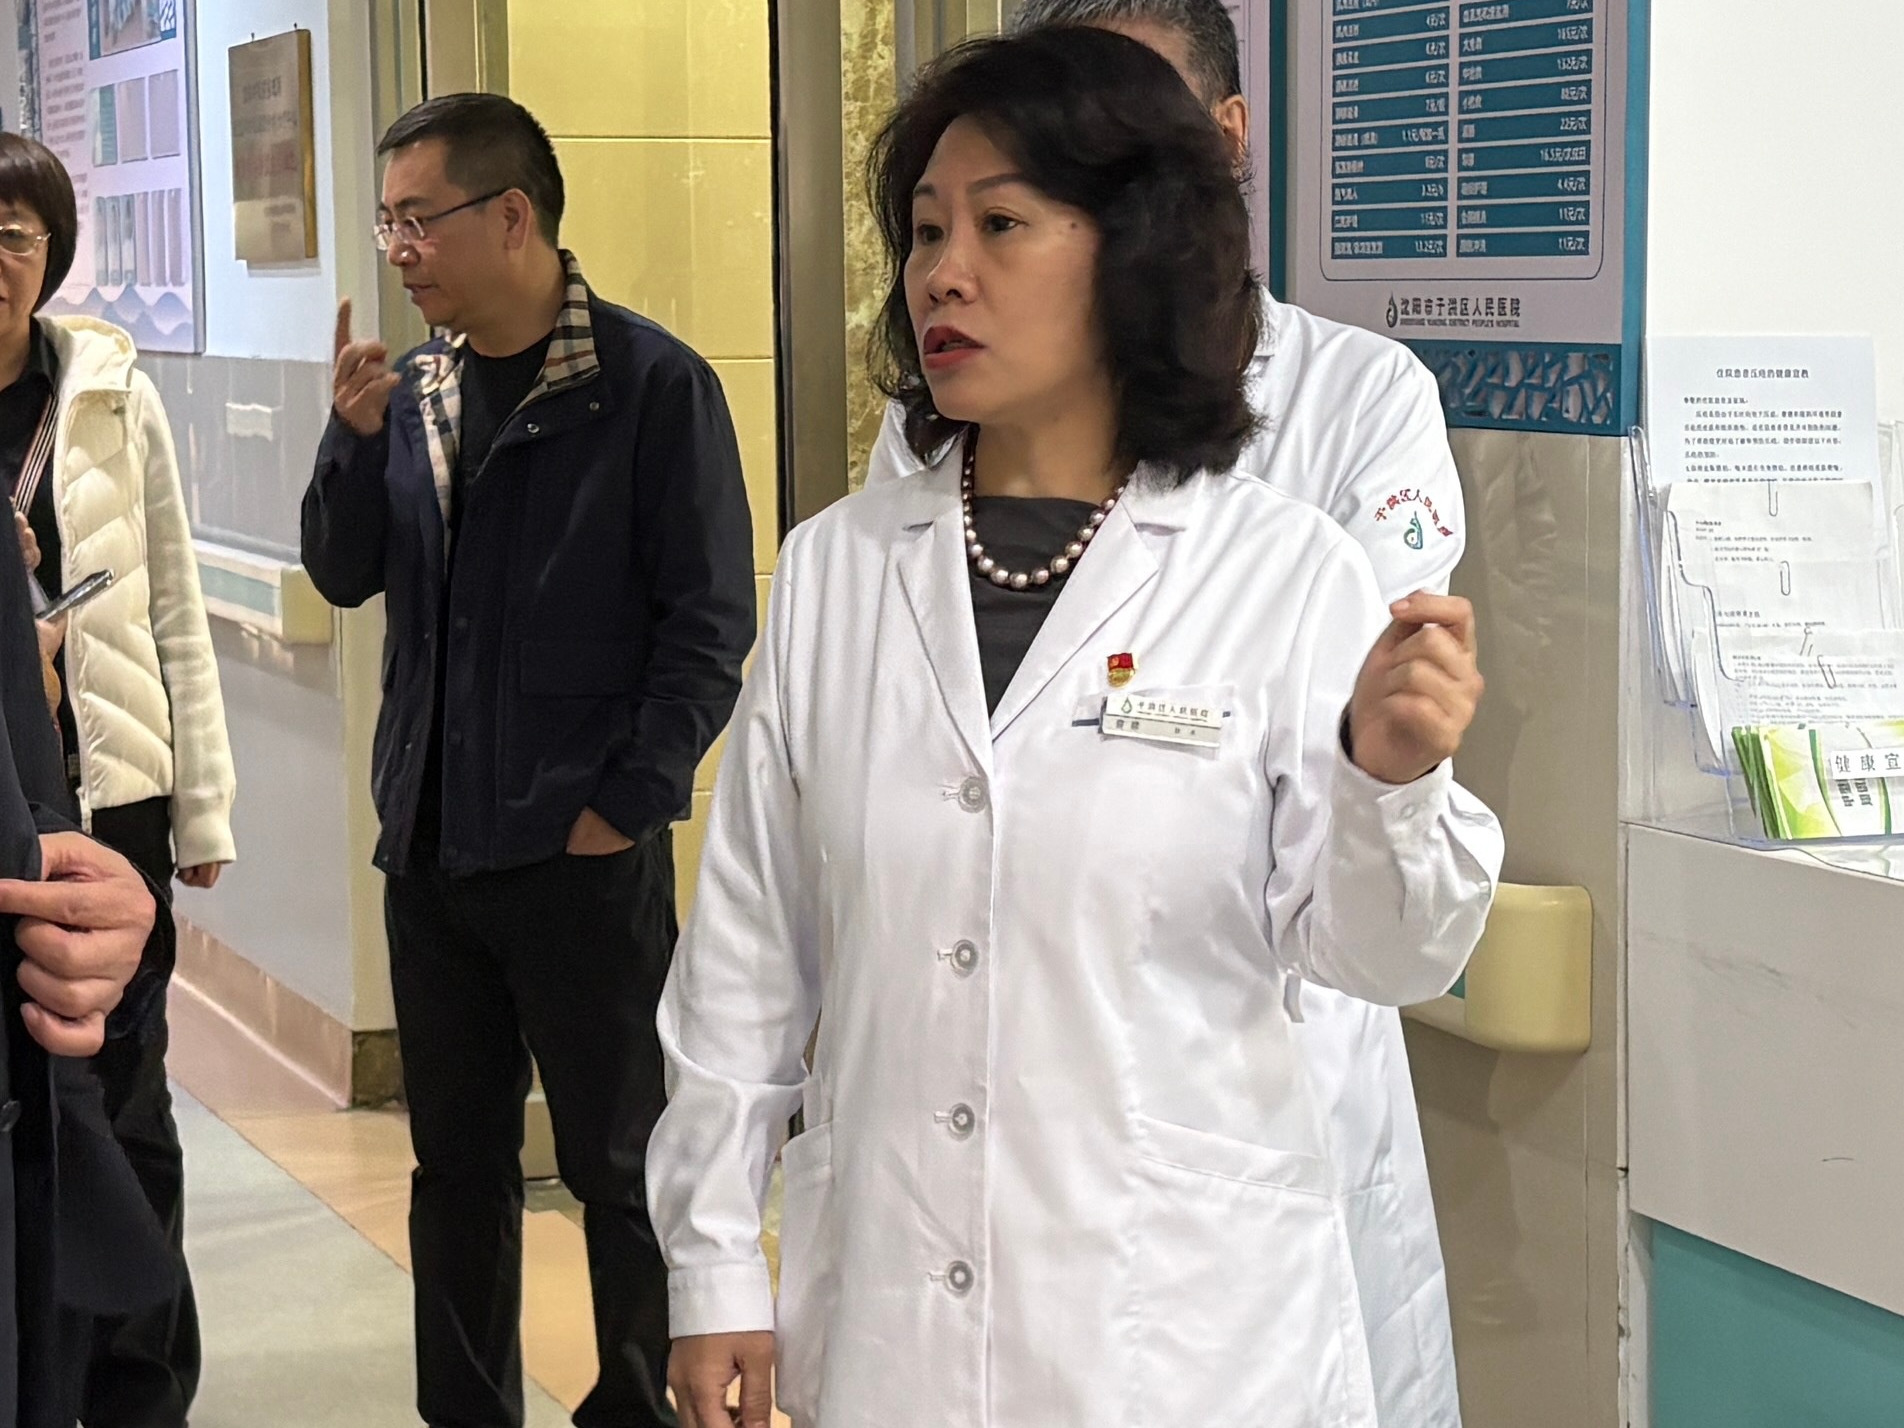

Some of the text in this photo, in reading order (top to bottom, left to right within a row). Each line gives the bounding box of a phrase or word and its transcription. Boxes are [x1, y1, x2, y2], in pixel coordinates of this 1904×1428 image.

[1400, 297, 1520, 317] 沈阳市于洪区人民医院
